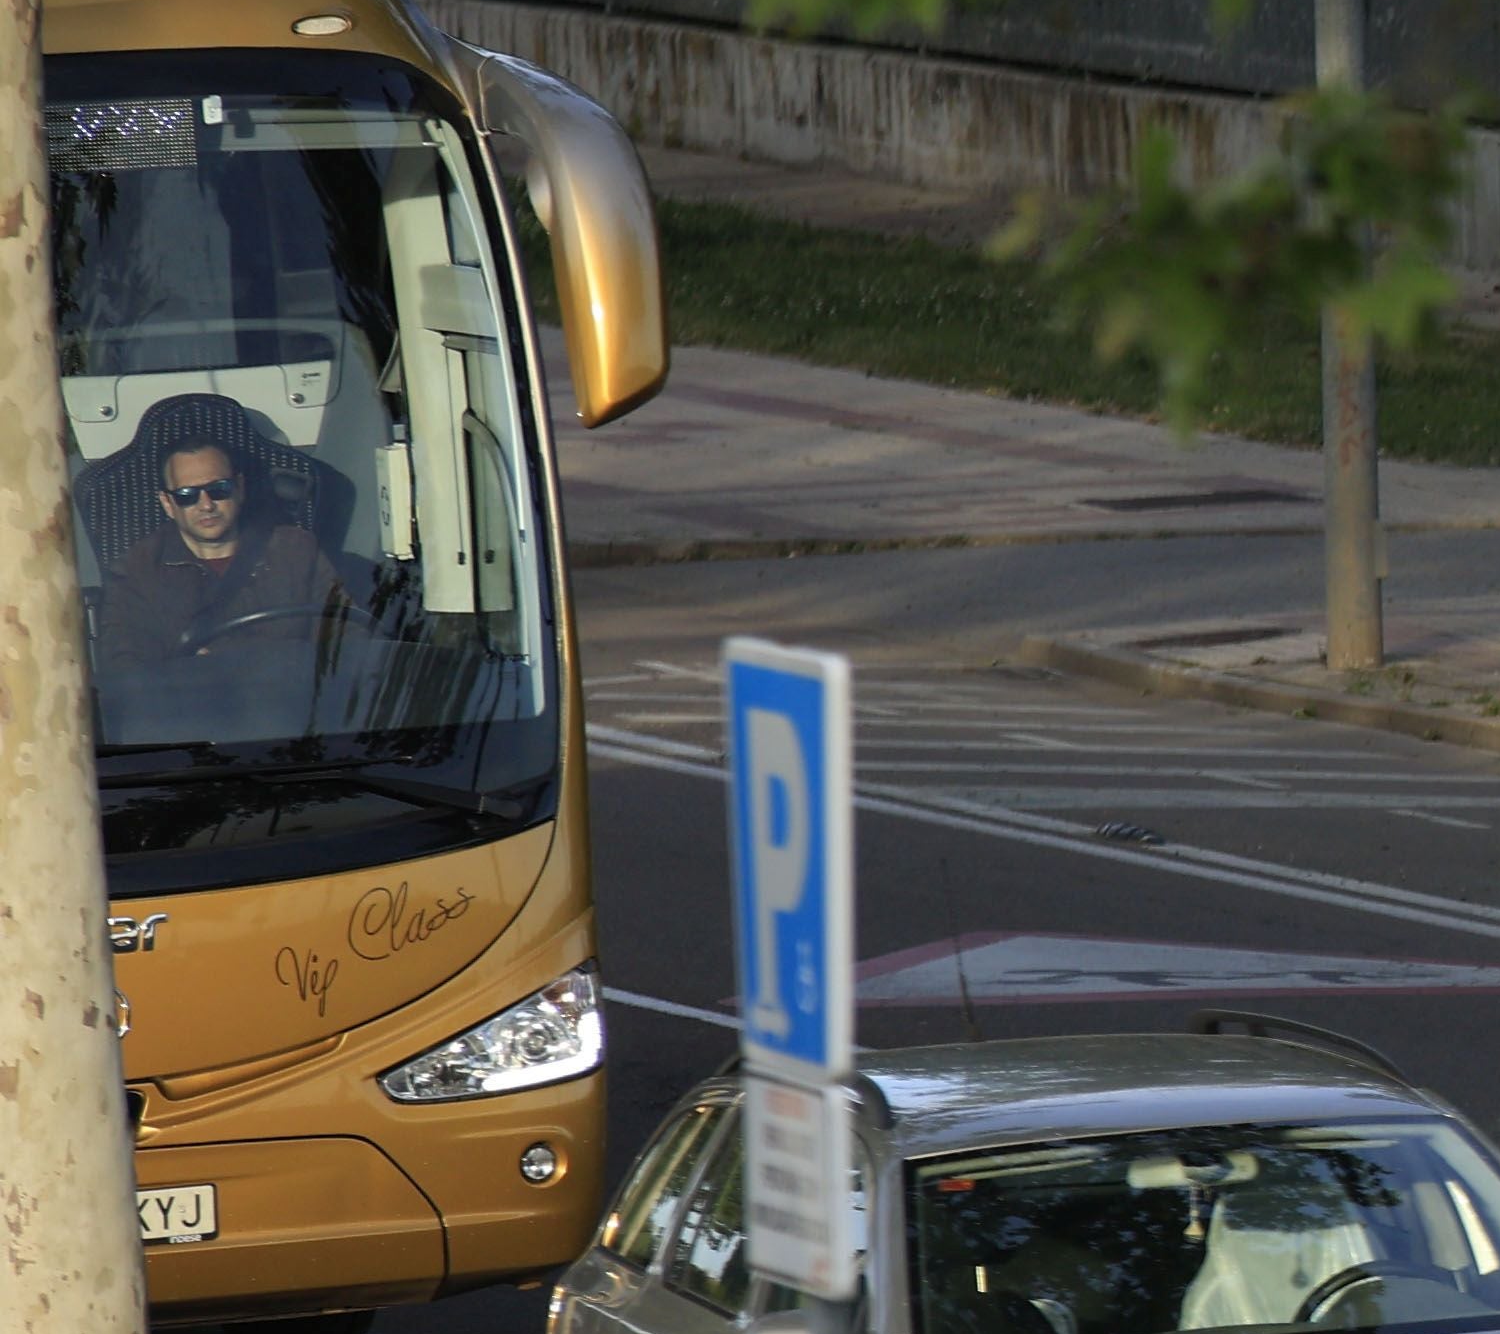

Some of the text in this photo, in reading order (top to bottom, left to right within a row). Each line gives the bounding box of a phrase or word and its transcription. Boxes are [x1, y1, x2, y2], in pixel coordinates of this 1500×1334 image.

[275, 880, 476, 1017] Vip Class
[745, 707, 811, 1005] P
